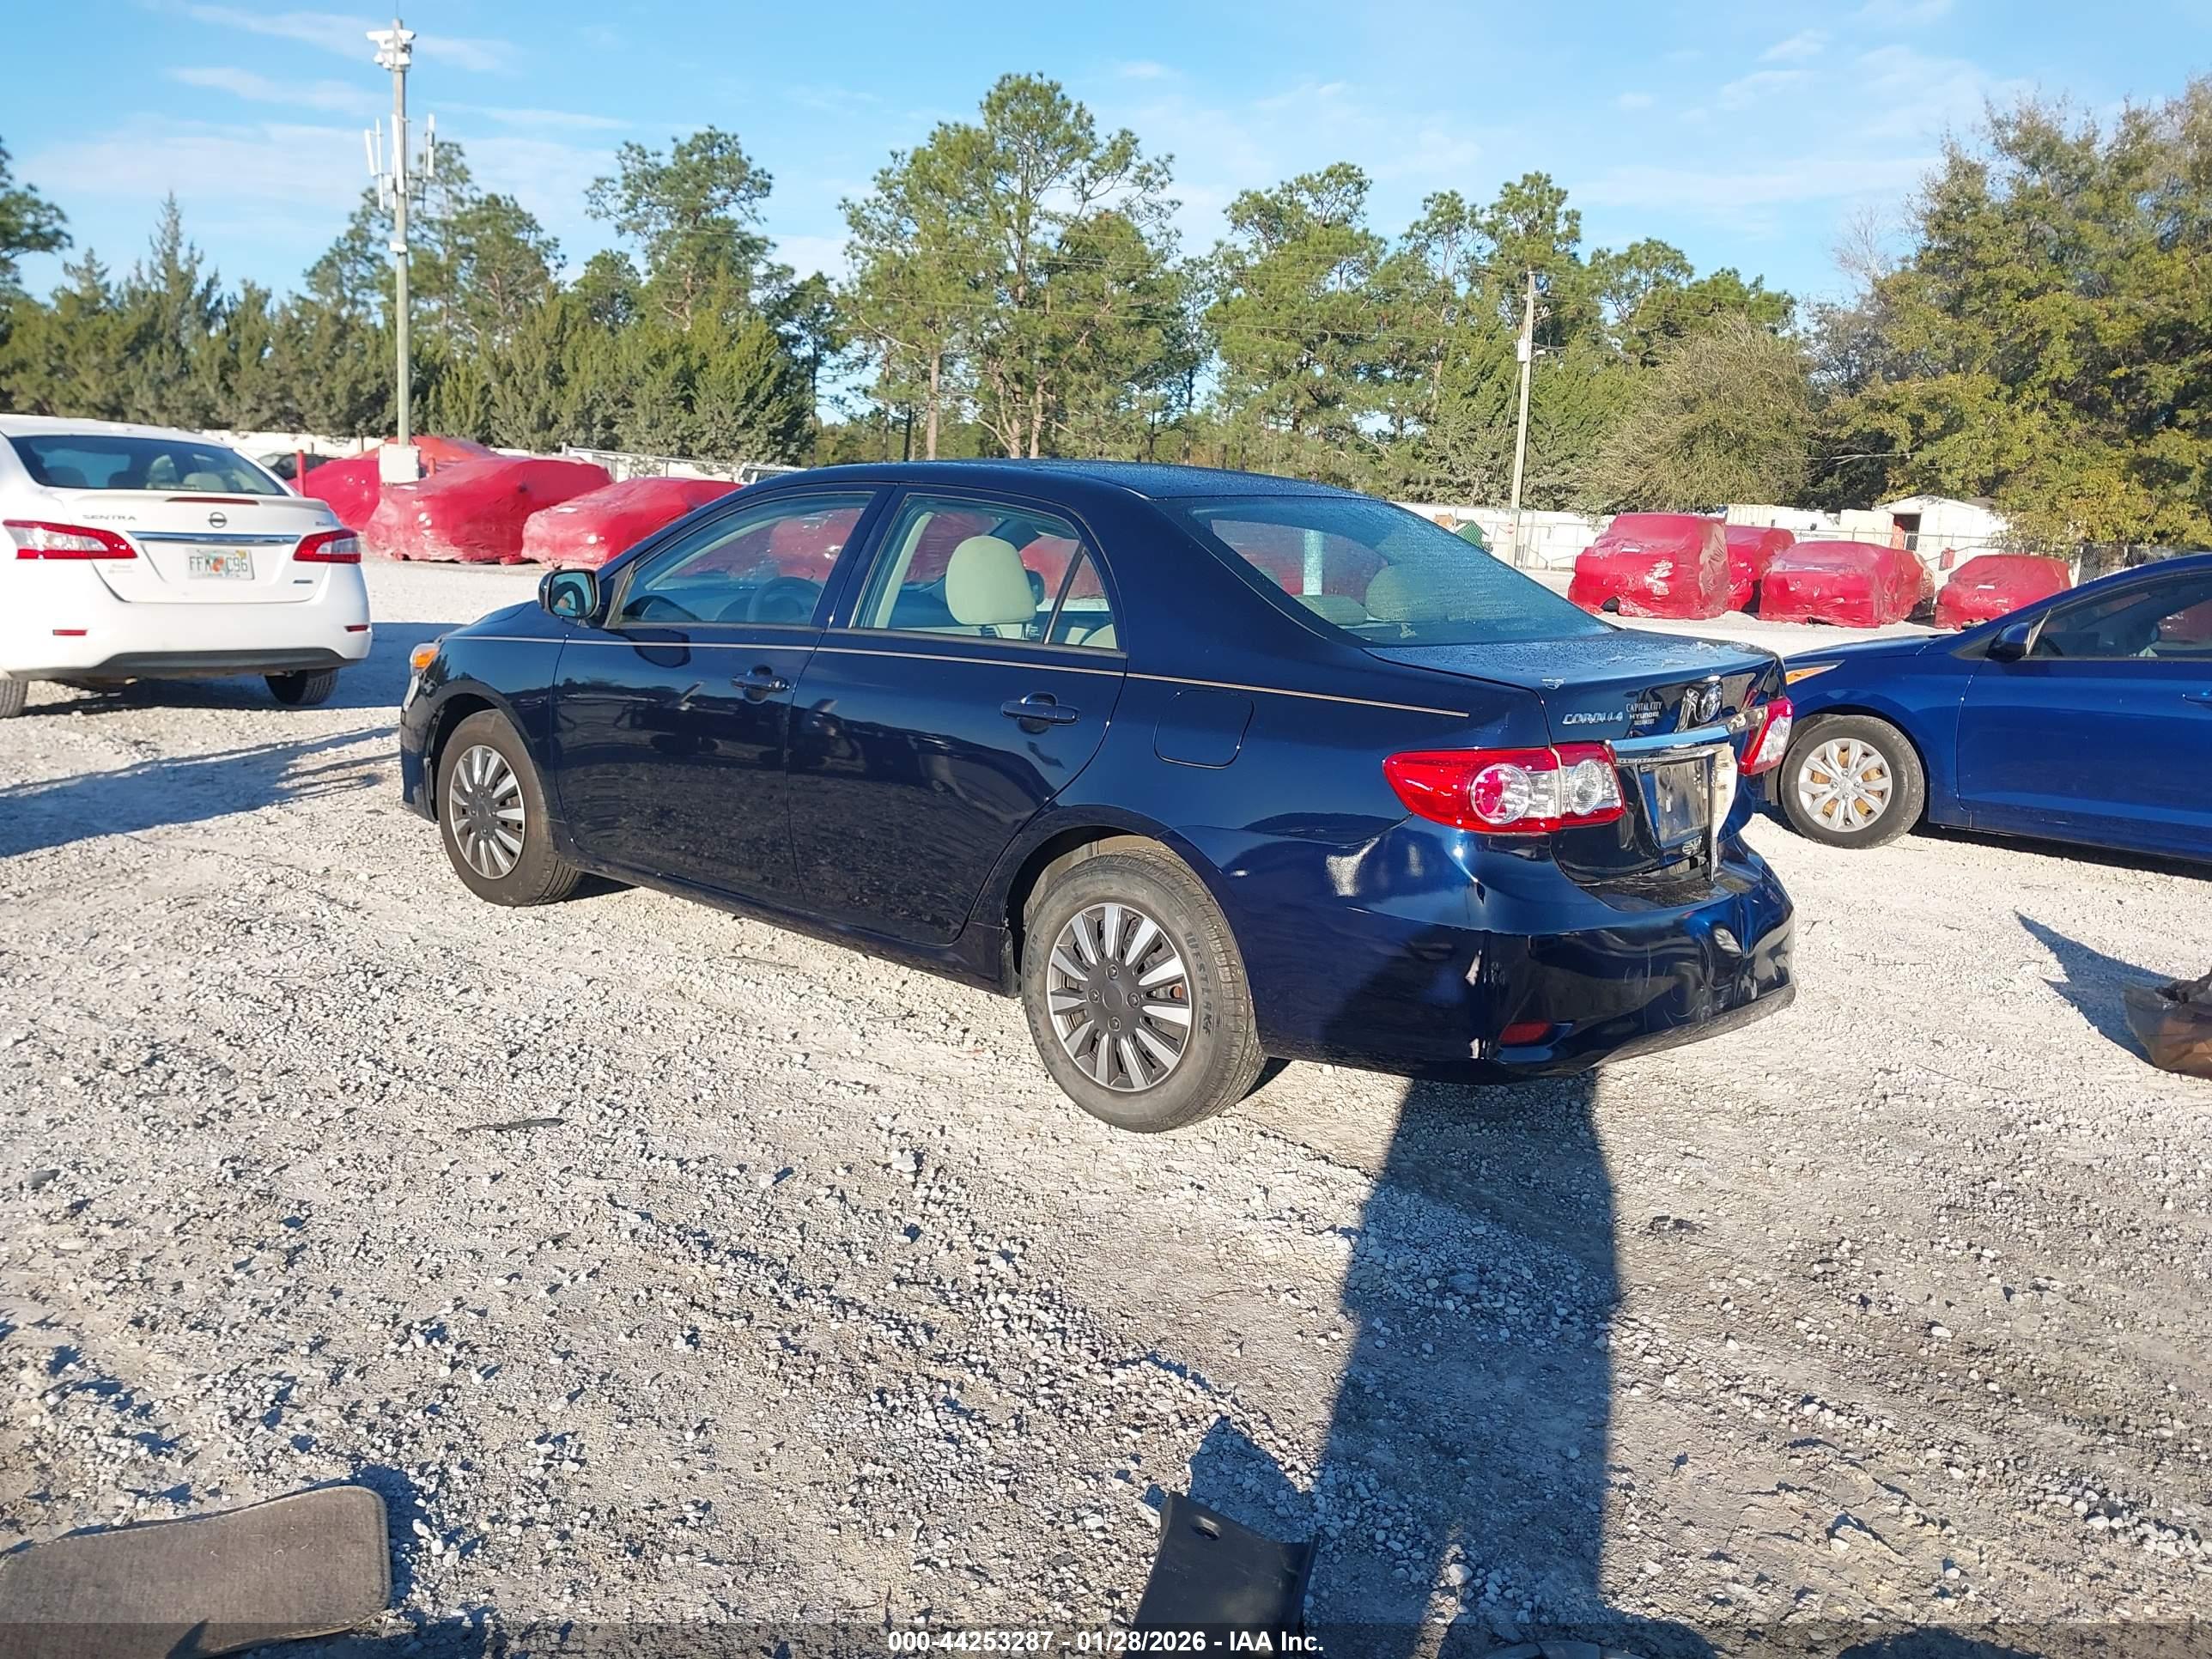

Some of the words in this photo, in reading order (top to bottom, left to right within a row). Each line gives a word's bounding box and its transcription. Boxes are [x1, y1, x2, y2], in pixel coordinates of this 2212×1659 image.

[1626, 702, 1649, 712] CAPITAL
[1650, 701, 1662, 710] CITY
[1562, 711, 1624, 725] COROLLA
[1629, 711, 1660, 720] HYUNDAI
[1185, 931, 1212, 1037] WESTLAKE
